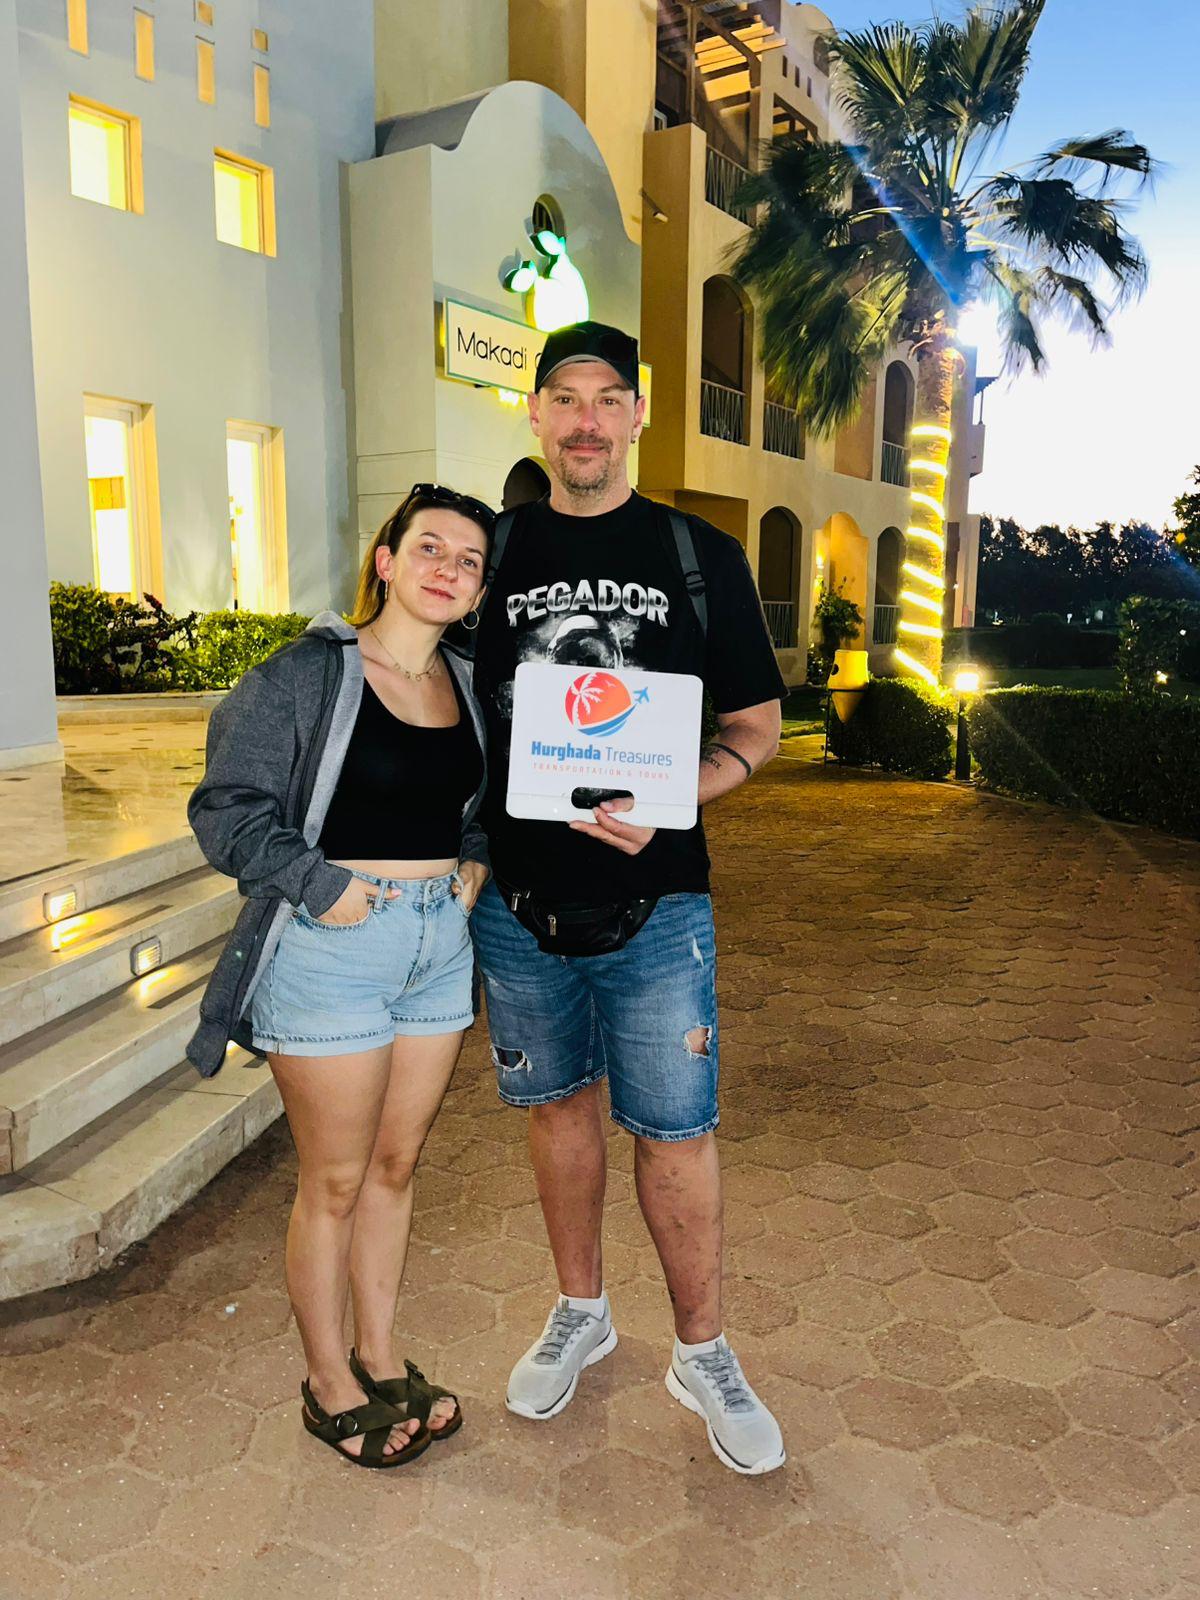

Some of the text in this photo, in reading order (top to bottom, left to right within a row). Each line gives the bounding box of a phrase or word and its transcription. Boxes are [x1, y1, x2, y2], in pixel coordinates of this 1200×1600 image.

[457, 327, 527, 370] Makadi
[506, 579, 669, 627] PEGADOR
[531, 741, 673, 766] Hurghada Treasures
[533, 762, 670, 780] TRANSPORTATION & TOURS
